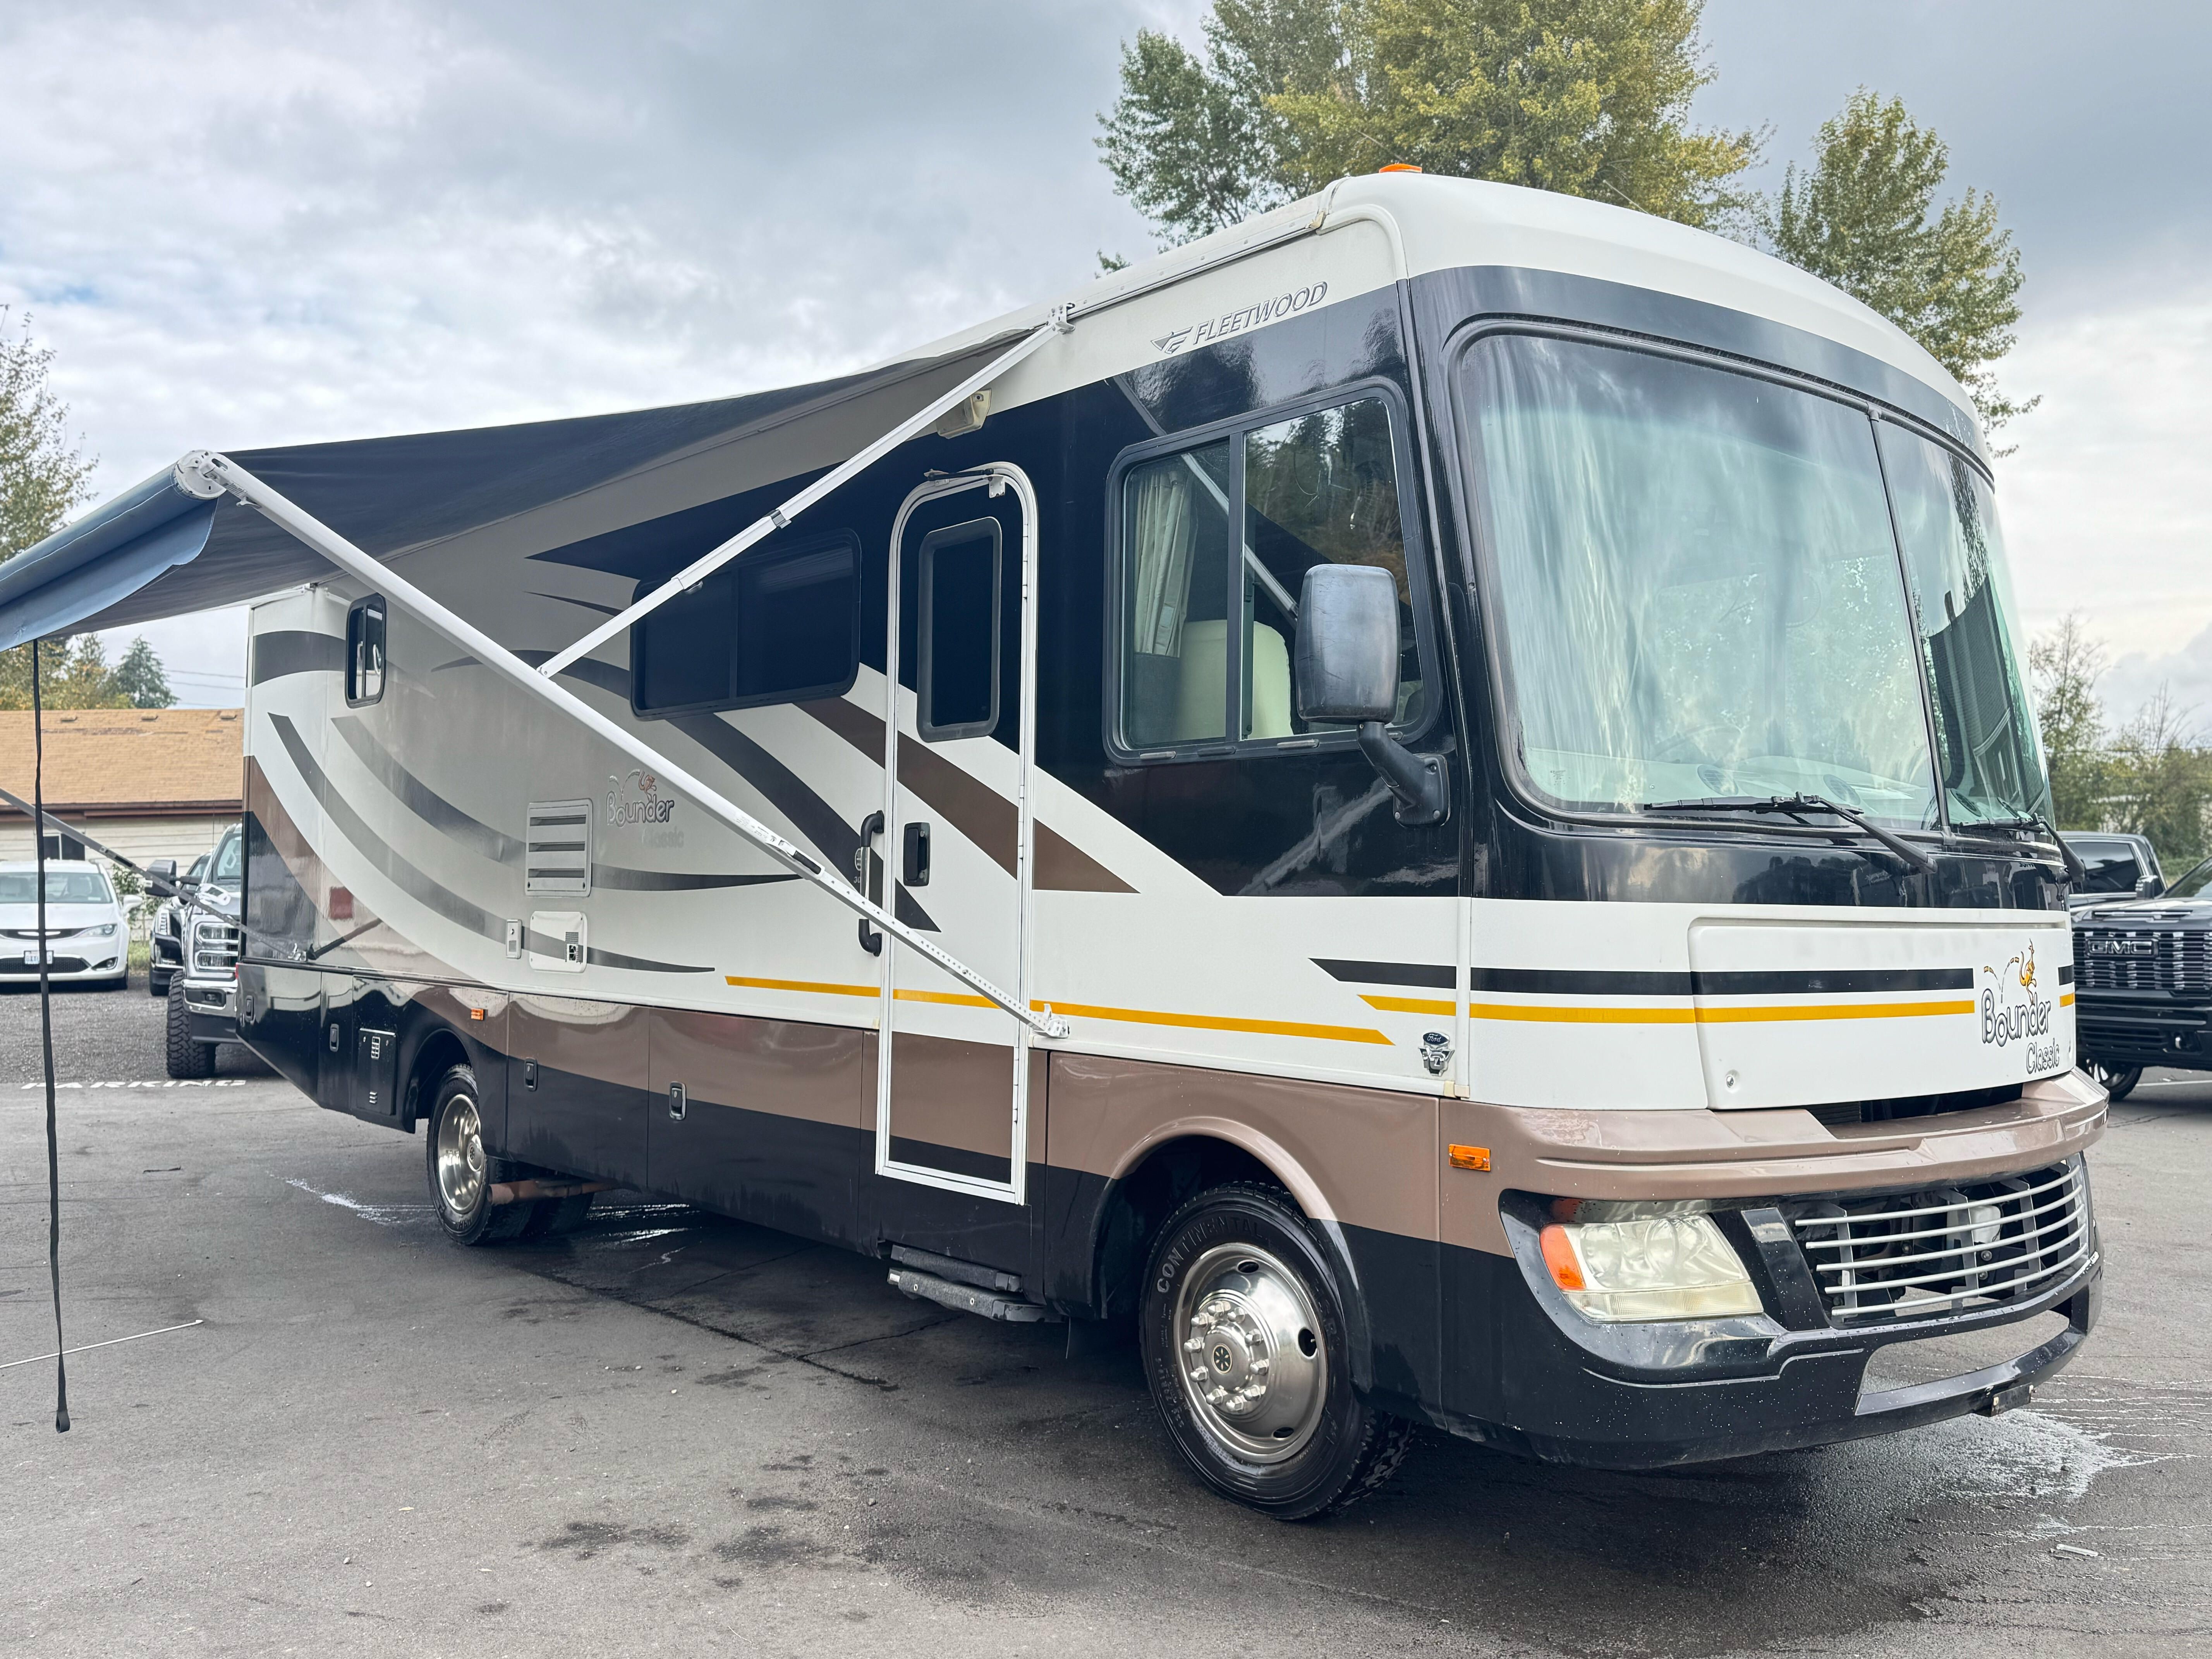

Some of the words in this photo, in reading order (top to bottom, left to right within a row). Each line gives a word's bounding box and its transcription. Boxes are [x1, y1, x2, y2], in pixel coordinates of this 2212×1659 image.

[1193, 281, 1328, 345] FLEETWOOD
[606, 791, 675, 828] Bounder
[2090, 941, 2152, 955] GMC
[1982, 988, 2051, 1047] Bounder
[1427, 1034, 1441, 1042] Ford
[2026, 1038, 2060, 1074] Classic
[1156, 1215, 1263, 1294] CONTINENTAL
